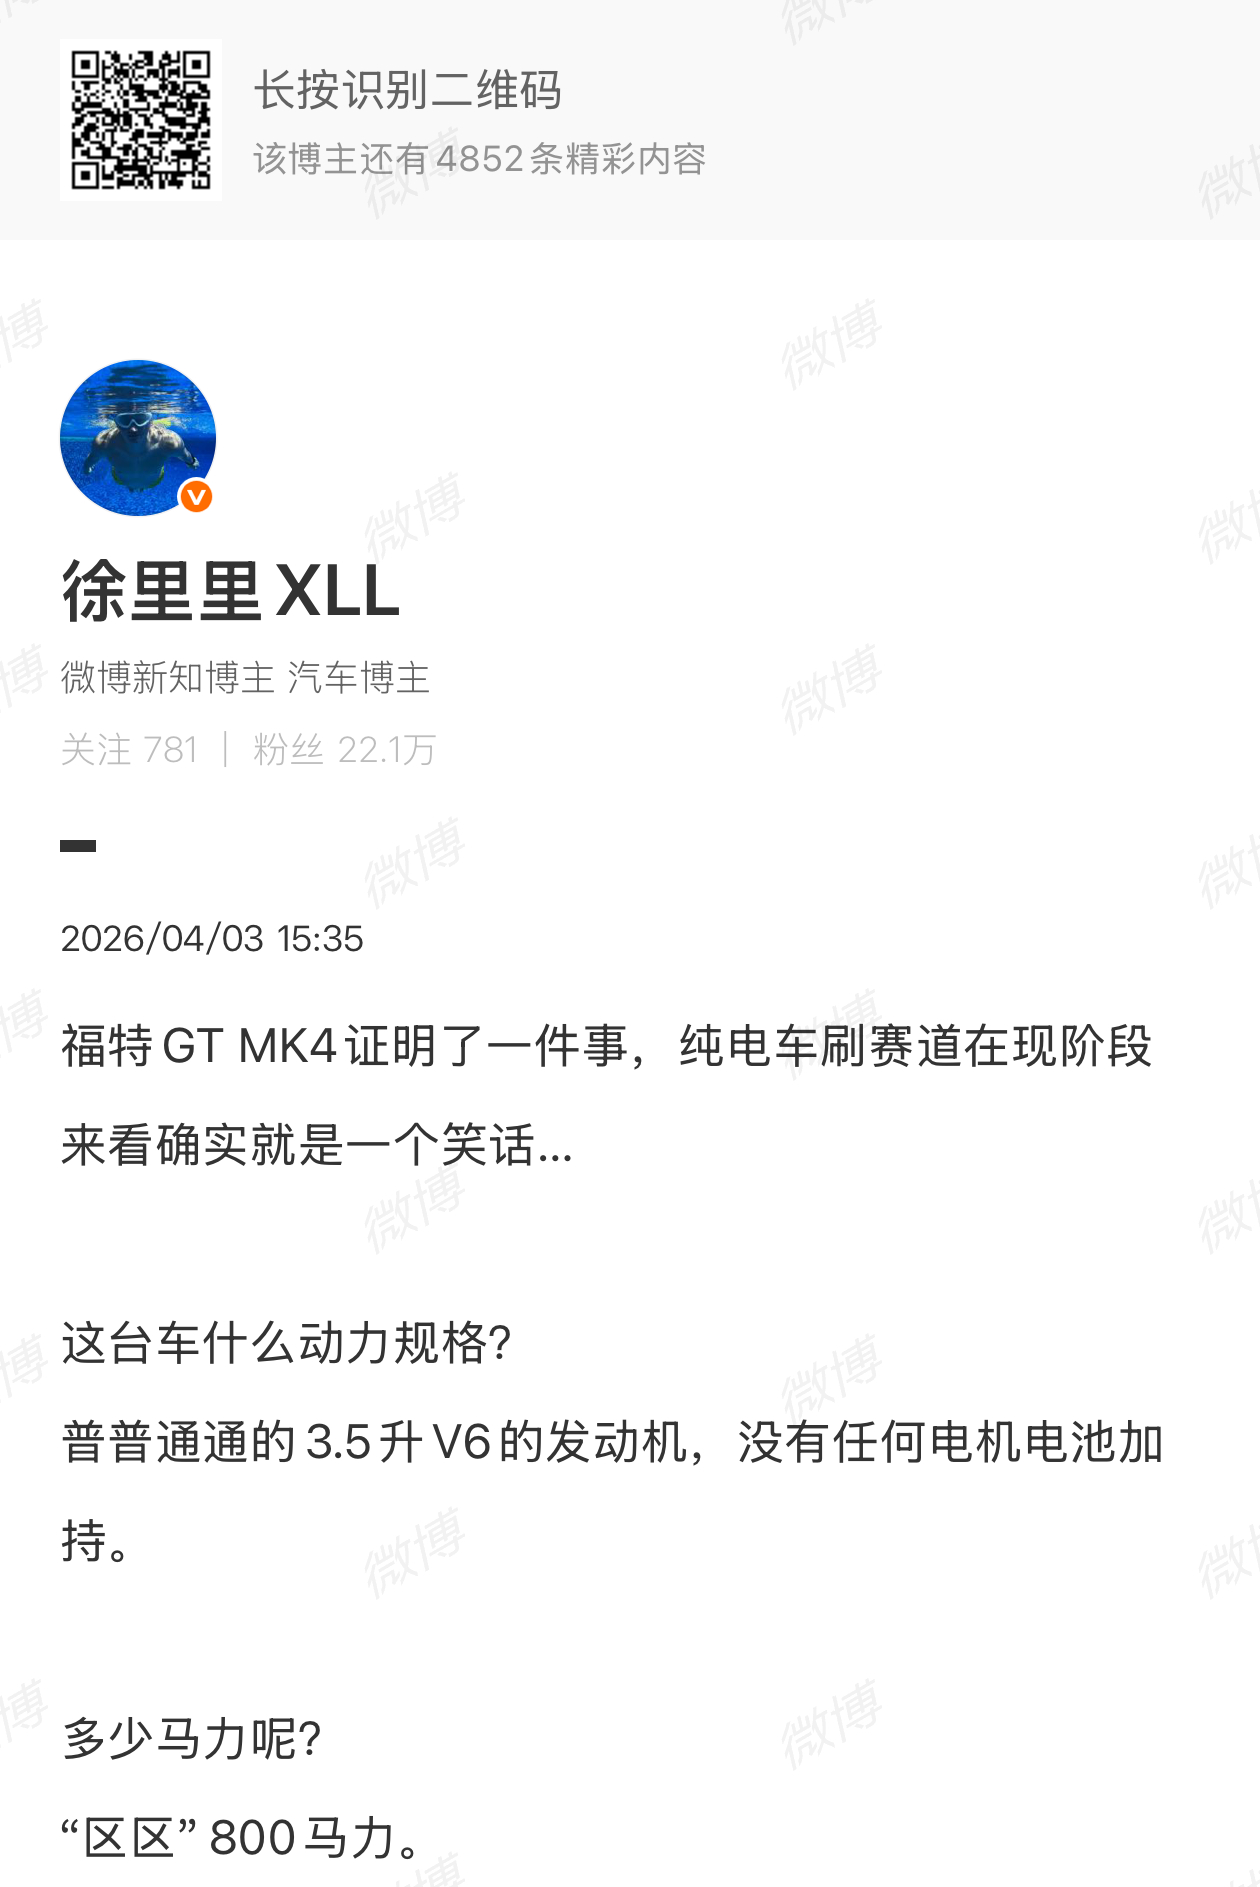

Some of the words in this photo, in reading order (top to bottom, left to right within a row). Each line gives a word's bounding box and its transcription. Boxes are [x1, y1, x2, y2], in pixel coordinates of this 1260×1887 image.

[254, 69, 560, 110] 长按识别二维码
[61, 660, 274, 694] 微博新知博主
[289, 660, 430, 694] 汽车博主
[63, 733, 130, 765] 关注
[145, 735, 196, 763] 781
[254, 733, 323, 765] 粉丝
[340, 734, 437, 766] 22.1万
[62, 921, 263, 955] 2026/04/03
[279, 924, 363, 953] 15:35
[62, 1519, 124, 1562] 持。
[65, 1717, 320, 1760] 多少马力呢？
